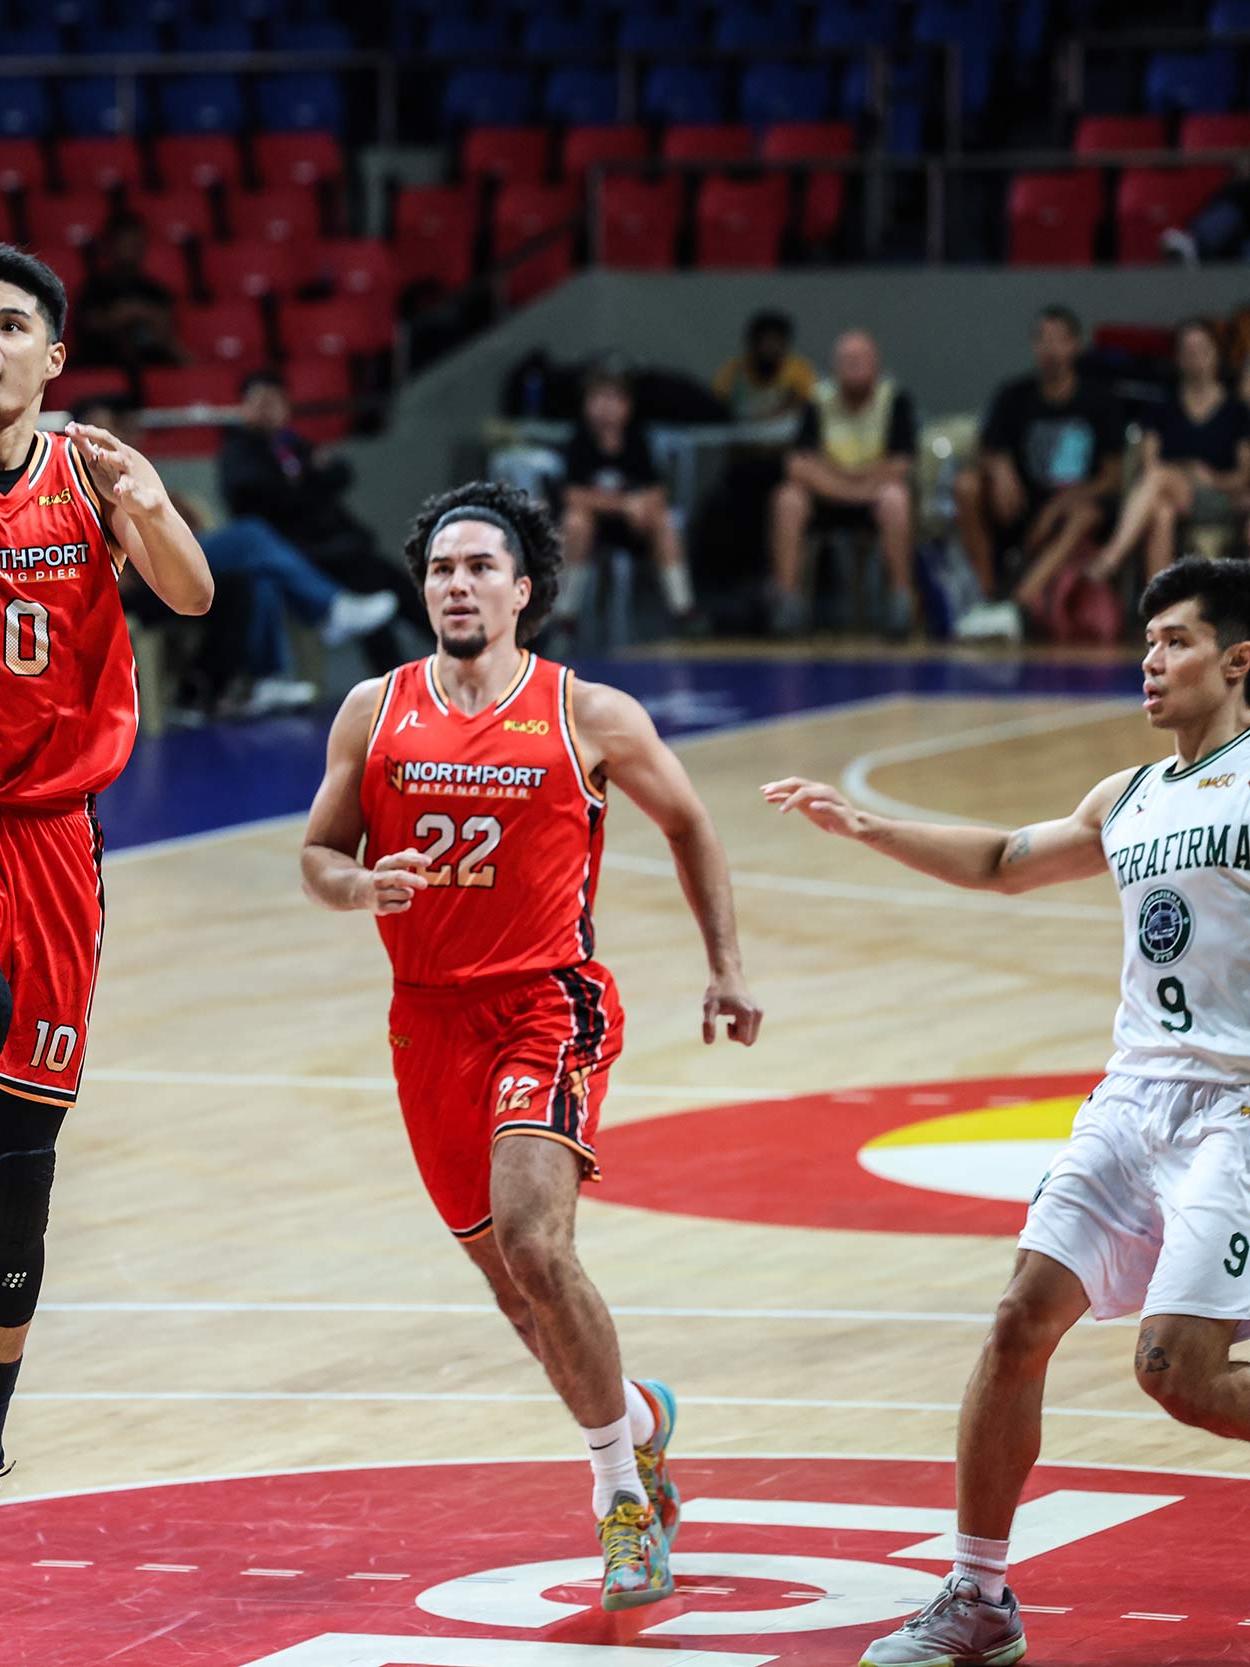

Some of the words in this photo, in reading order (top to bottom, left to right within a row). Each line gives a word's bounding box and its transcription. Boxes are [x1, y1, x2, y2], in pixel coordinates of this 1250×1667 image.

[39, 487, 71, 506] PBA5
[36, 567, 76, 581] PIER
[404, 761, 547, 788] NORTHPORT
[407, 782, 480, 797] BATANG
[486, 786, 529, 798] PIER
[415, 812, 502, 888] 22
[1156, 975, 1193, 1033] 9
[30, 1019, 78, 1072] 10
[495, 1075, 540, 1116] 22
[1223, 1231, 1250, 1278] 9
